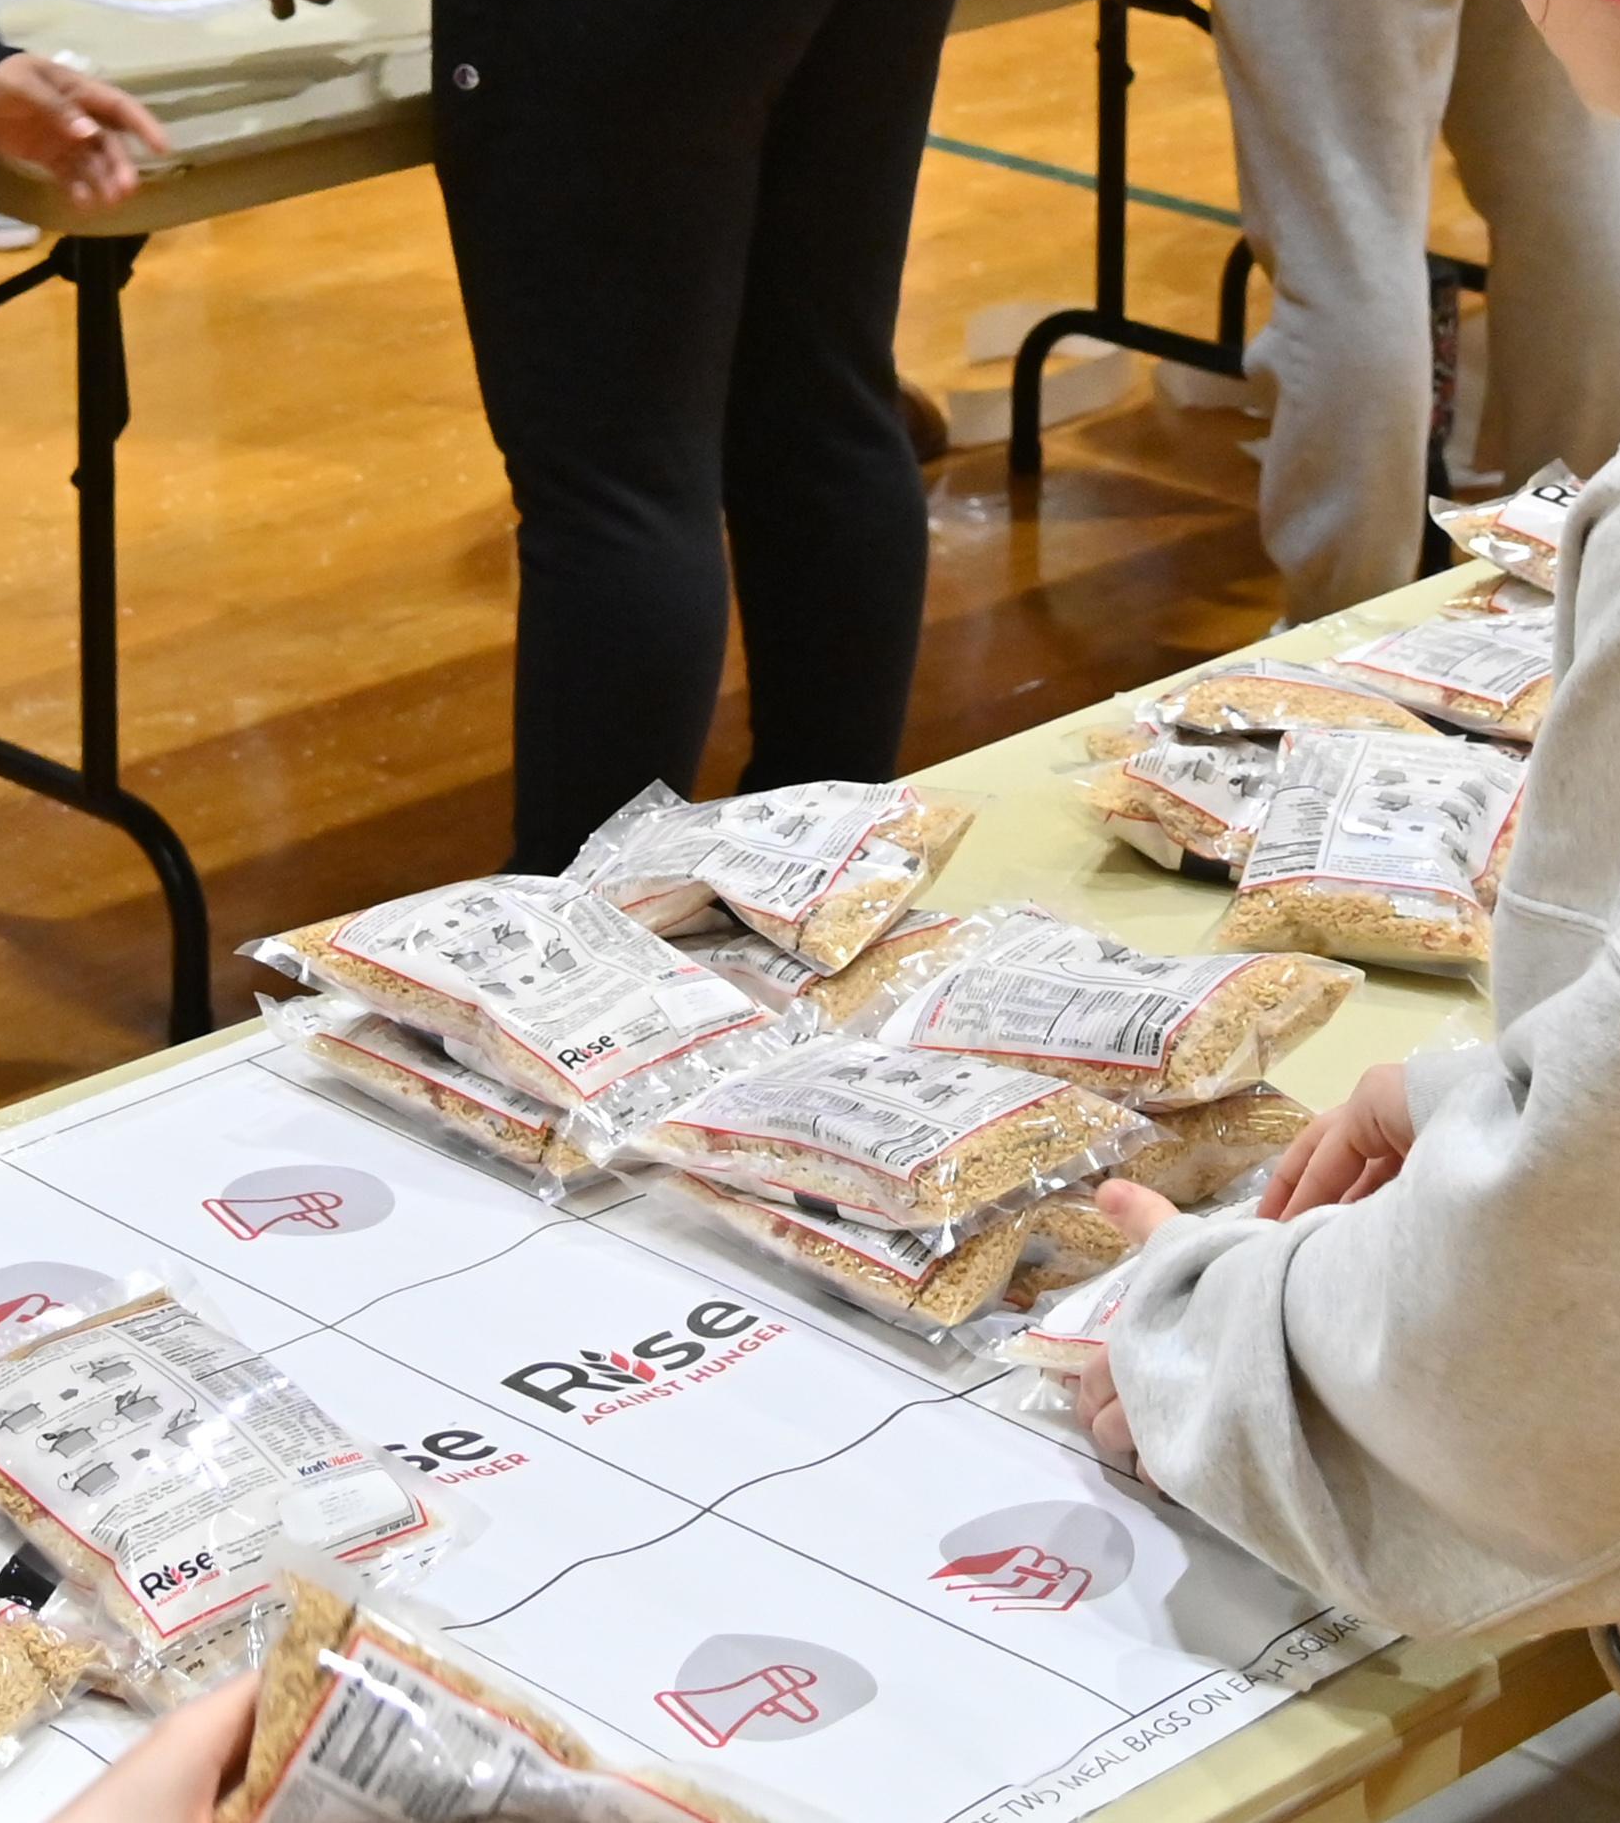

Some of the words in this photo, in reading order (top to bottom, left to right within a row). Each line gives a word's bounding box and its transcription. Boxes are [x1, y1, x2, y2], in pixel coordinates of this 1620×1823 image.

[557, 1034, 616, 1071] Rise
[500, 1300, 760, 1414] Rise
[580, 1379, 686, 1427] AGAINST
[685, 1321, 791, 1384] HUNGER
[434, 1452, 531, 1486] UNGER
[139, 1551, 214, 1600] Rise
[1058, 1748, 1131, 1791] MEAL
[1121, 1709, 1192, 1754] BAGS
[1187, 1687, 1233, 1716] ON
[1225, 1657, 1293, 1694] EAH
[1286, 1613, 1368, 1662] SQUAR
